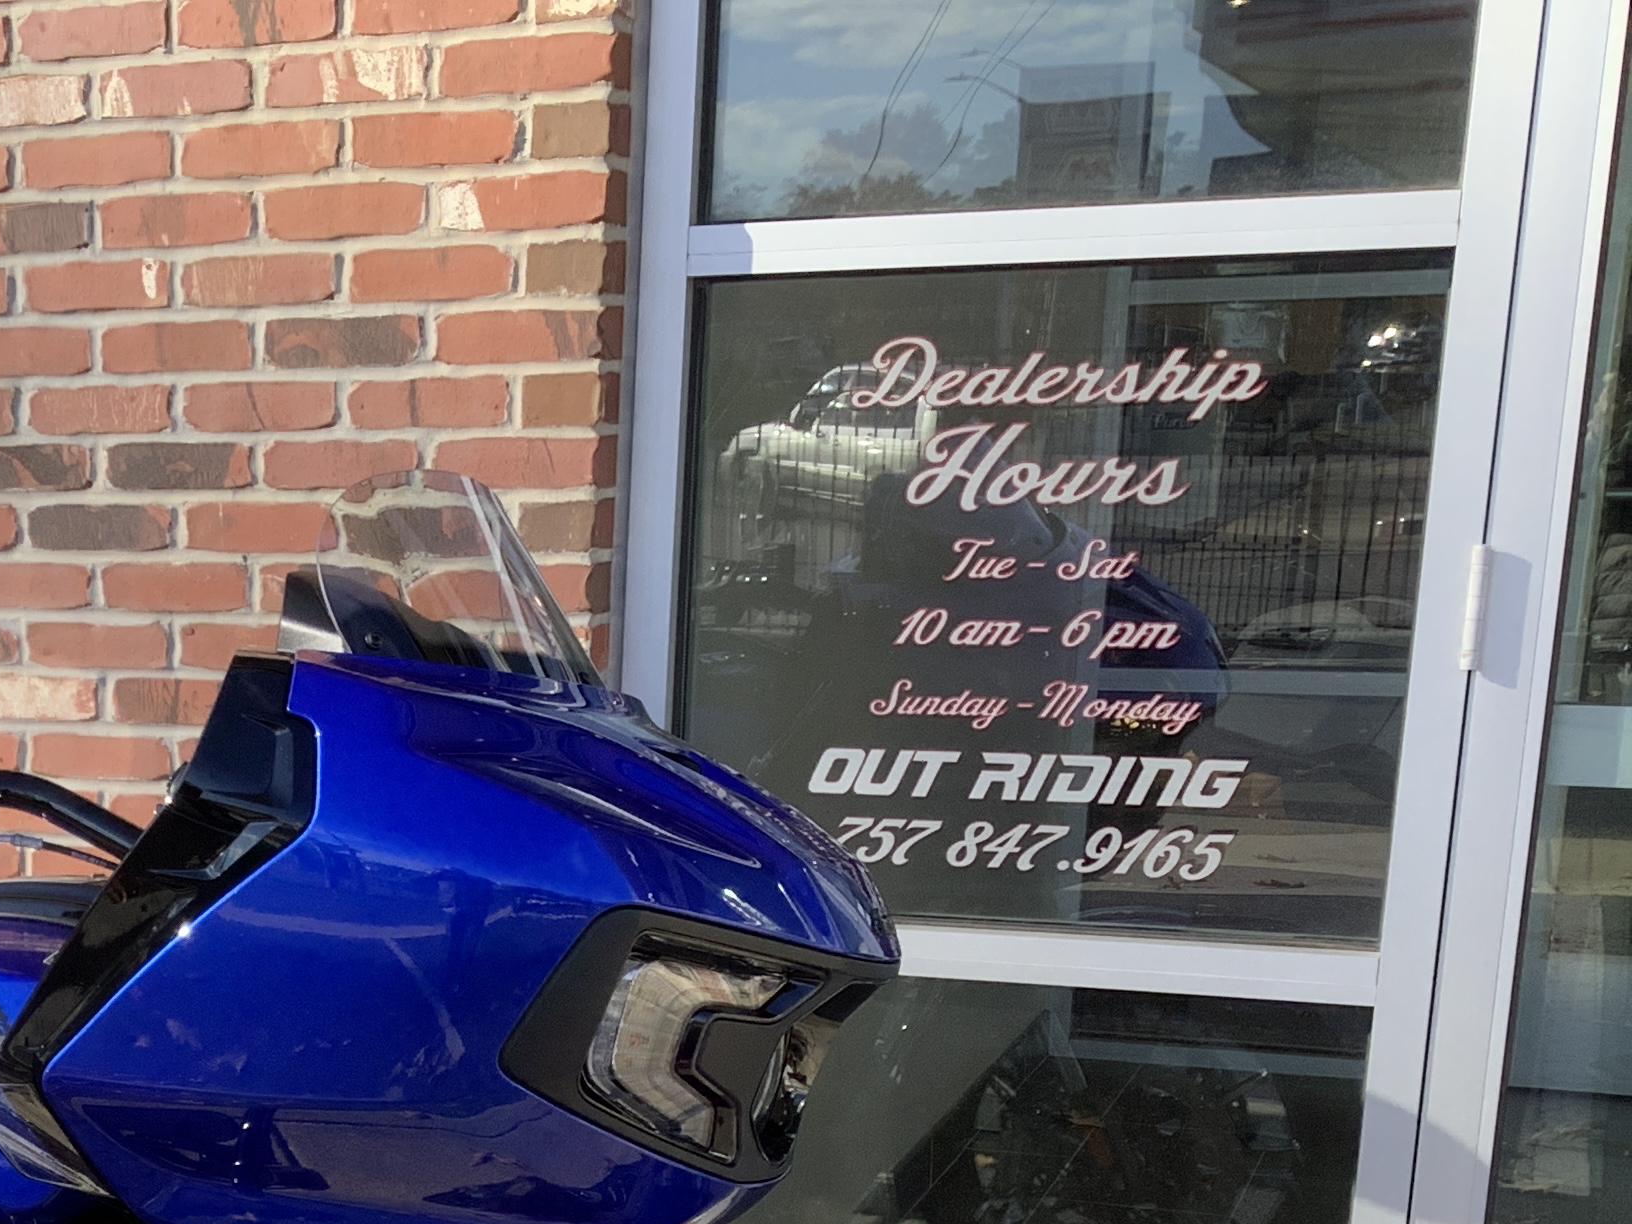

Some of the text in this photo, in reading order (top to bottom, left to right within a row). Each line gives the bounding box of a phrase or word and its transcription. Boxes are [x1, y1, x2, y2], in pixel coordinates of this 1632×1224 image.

[852, 336, 1268, 421] Dealership
[906, 422, 1189, 511] Hours
[941, 537, 1017, 582] Tue
[1056, 537, 1138, 581] Sat
[894, 608, 948, 646] 10
[949, 619, 1021, 647] am
[1061, 609, 1103, 648] 6
[1087, 620, 1180, 660] pm
[869, 679, 1008, 731] Sunday
[1038, 681, 1202, 735] Monday
[808, 747, 1249, 809] OUT RIDING
[827, 816, 1235, 881] 757 847.9165
